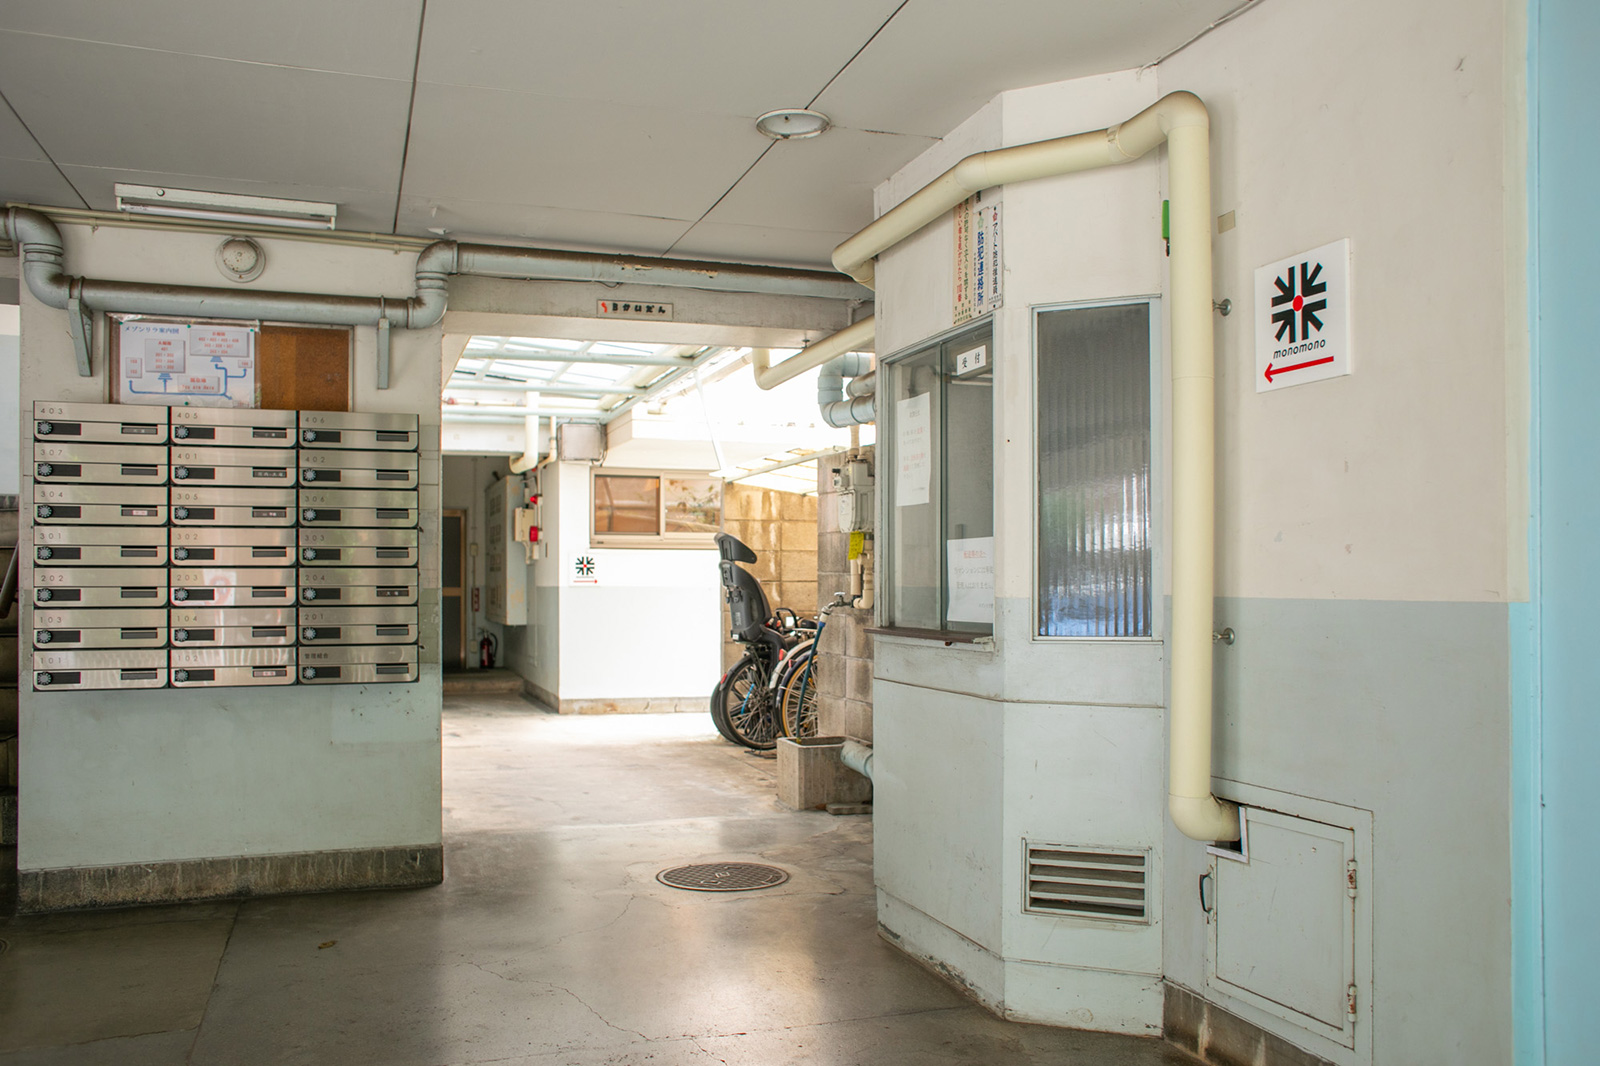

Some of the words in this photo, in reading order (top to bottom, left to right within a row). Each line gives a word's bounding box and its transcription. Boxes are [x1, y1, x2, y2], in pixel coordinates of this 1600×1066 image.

[1273, 339, 1326, 360] monomono
[961, 352, 980, 369] 受付
[305, 416, 325, 424] 406
[41, 490, 63, 498] 304
[40, 532, 62, 540] 301
[305, 534, 325, 542] 303
